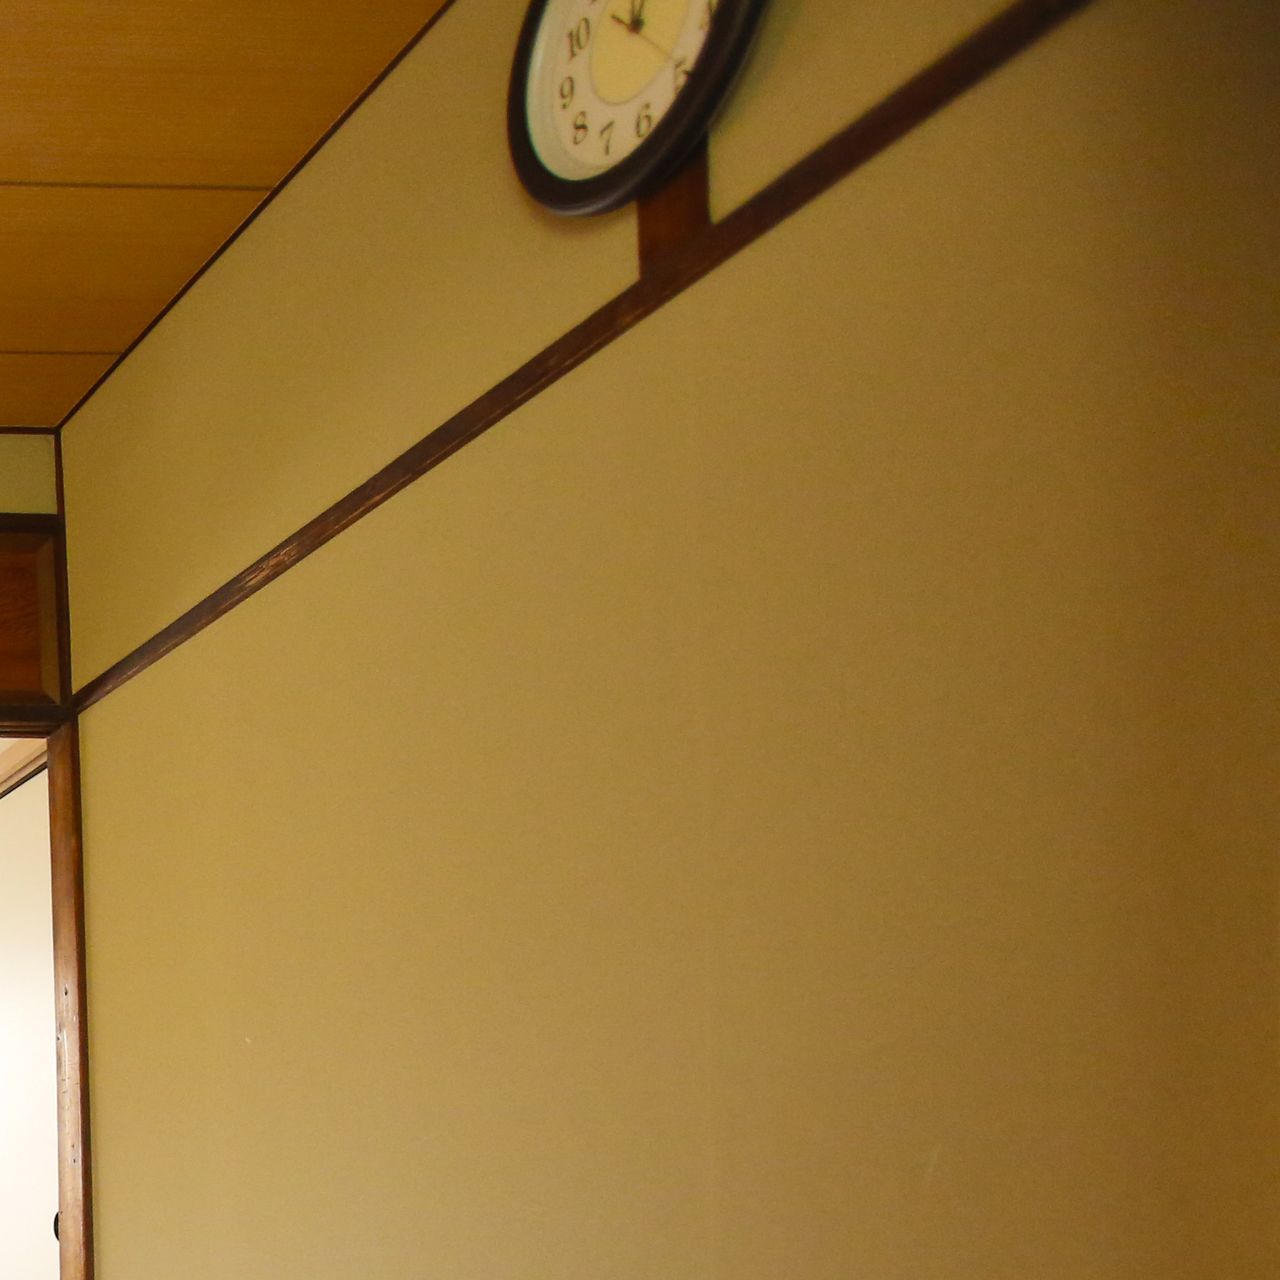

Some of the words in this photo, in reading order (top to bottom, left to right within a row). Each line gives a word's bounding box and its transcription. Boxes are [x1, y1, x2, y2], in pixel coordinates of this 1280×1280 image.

[567, 17, 591, 59] 10
[559, 76, 574, 109] 9
[573, 111, 588, 145] 8
[600, 120, 615, 156] 7
[636, 103, 652, 138] 6
